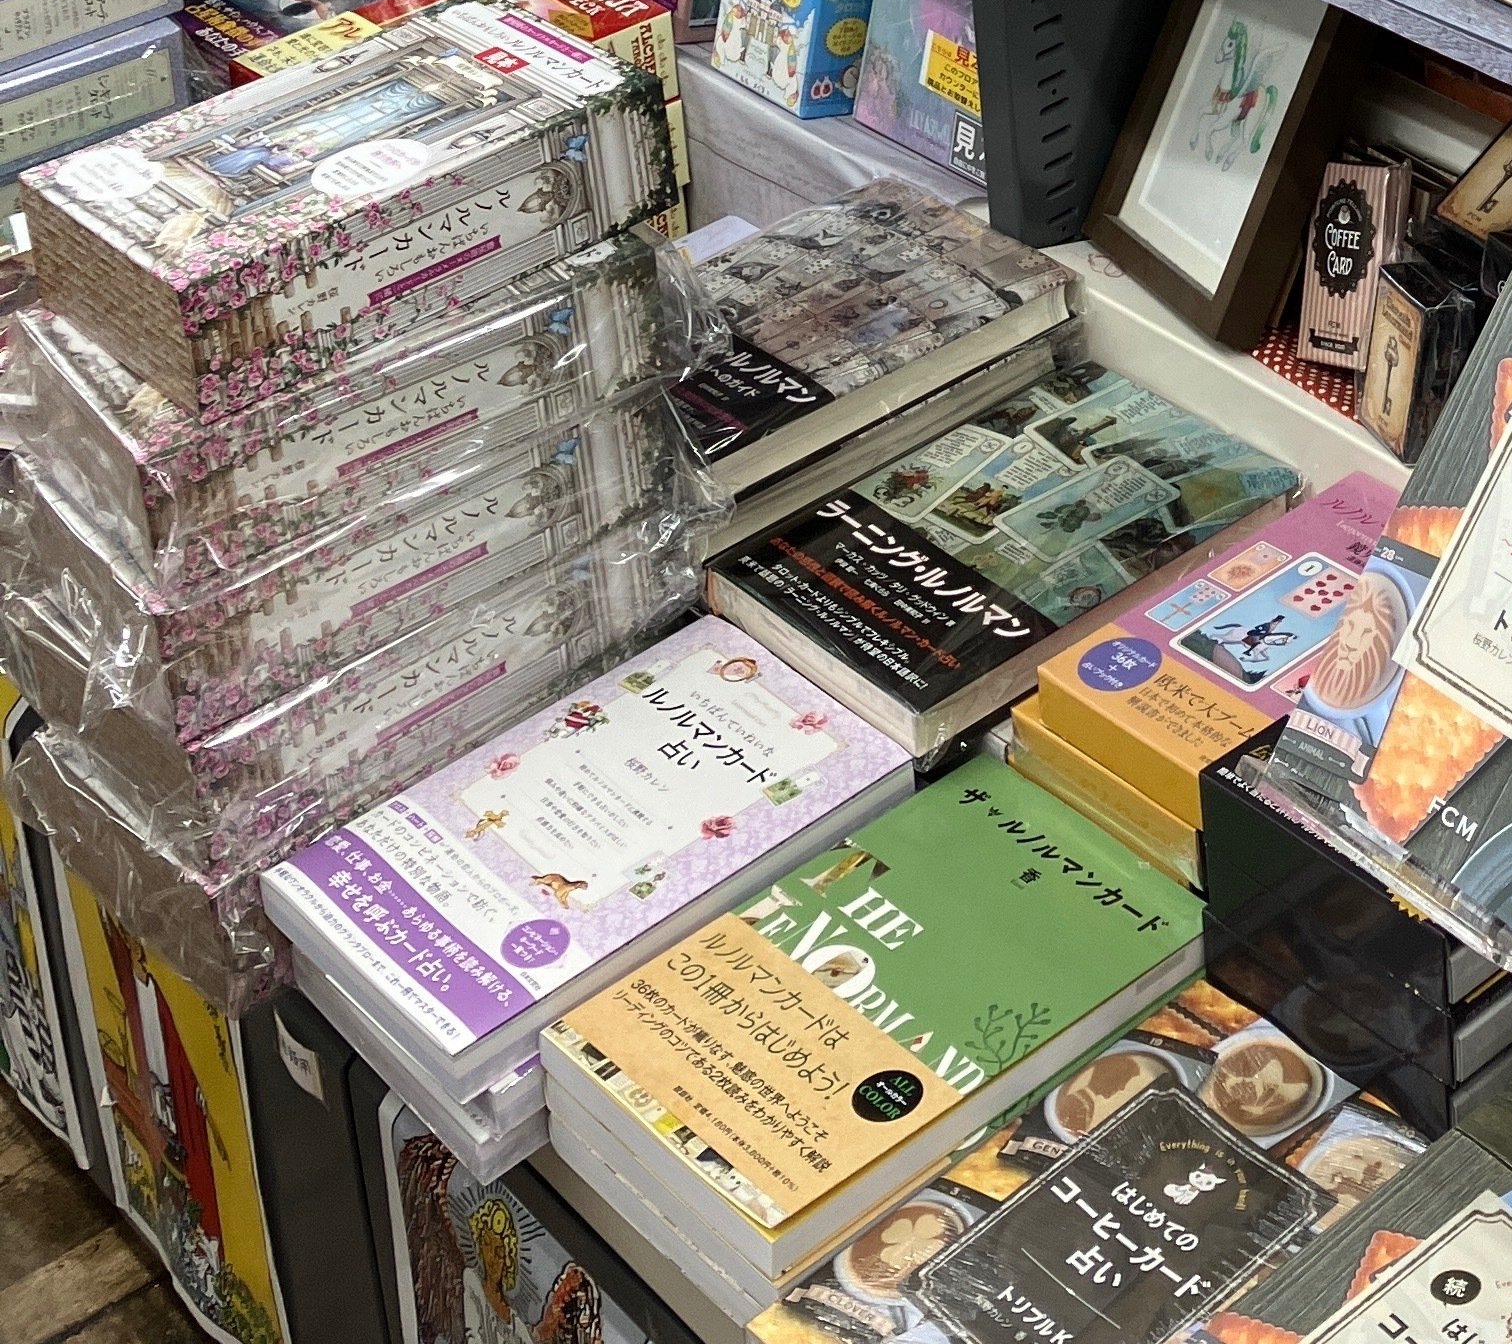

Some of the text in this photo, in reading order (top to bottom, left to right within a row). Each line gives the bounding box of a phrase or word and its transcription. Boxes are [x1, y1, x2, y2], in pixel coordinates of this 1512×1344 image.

[1323, 221, 1362, 252] COFFEE
[1327, 251, 1354, 278] CARD
[641, 687, 780, 788] ルノルマンカード
[657, 736, 701, 772] 占い
[1425, 796, 1479, 842] FCM
[700, 932, 851, 1050] ルノルマンカードは
[1049, 1175, 1211, 1300] コーヒーカード
[1111, 1181, 1199, 1253] はじめての
[1066, 1248, 1122, 1290] 占い
